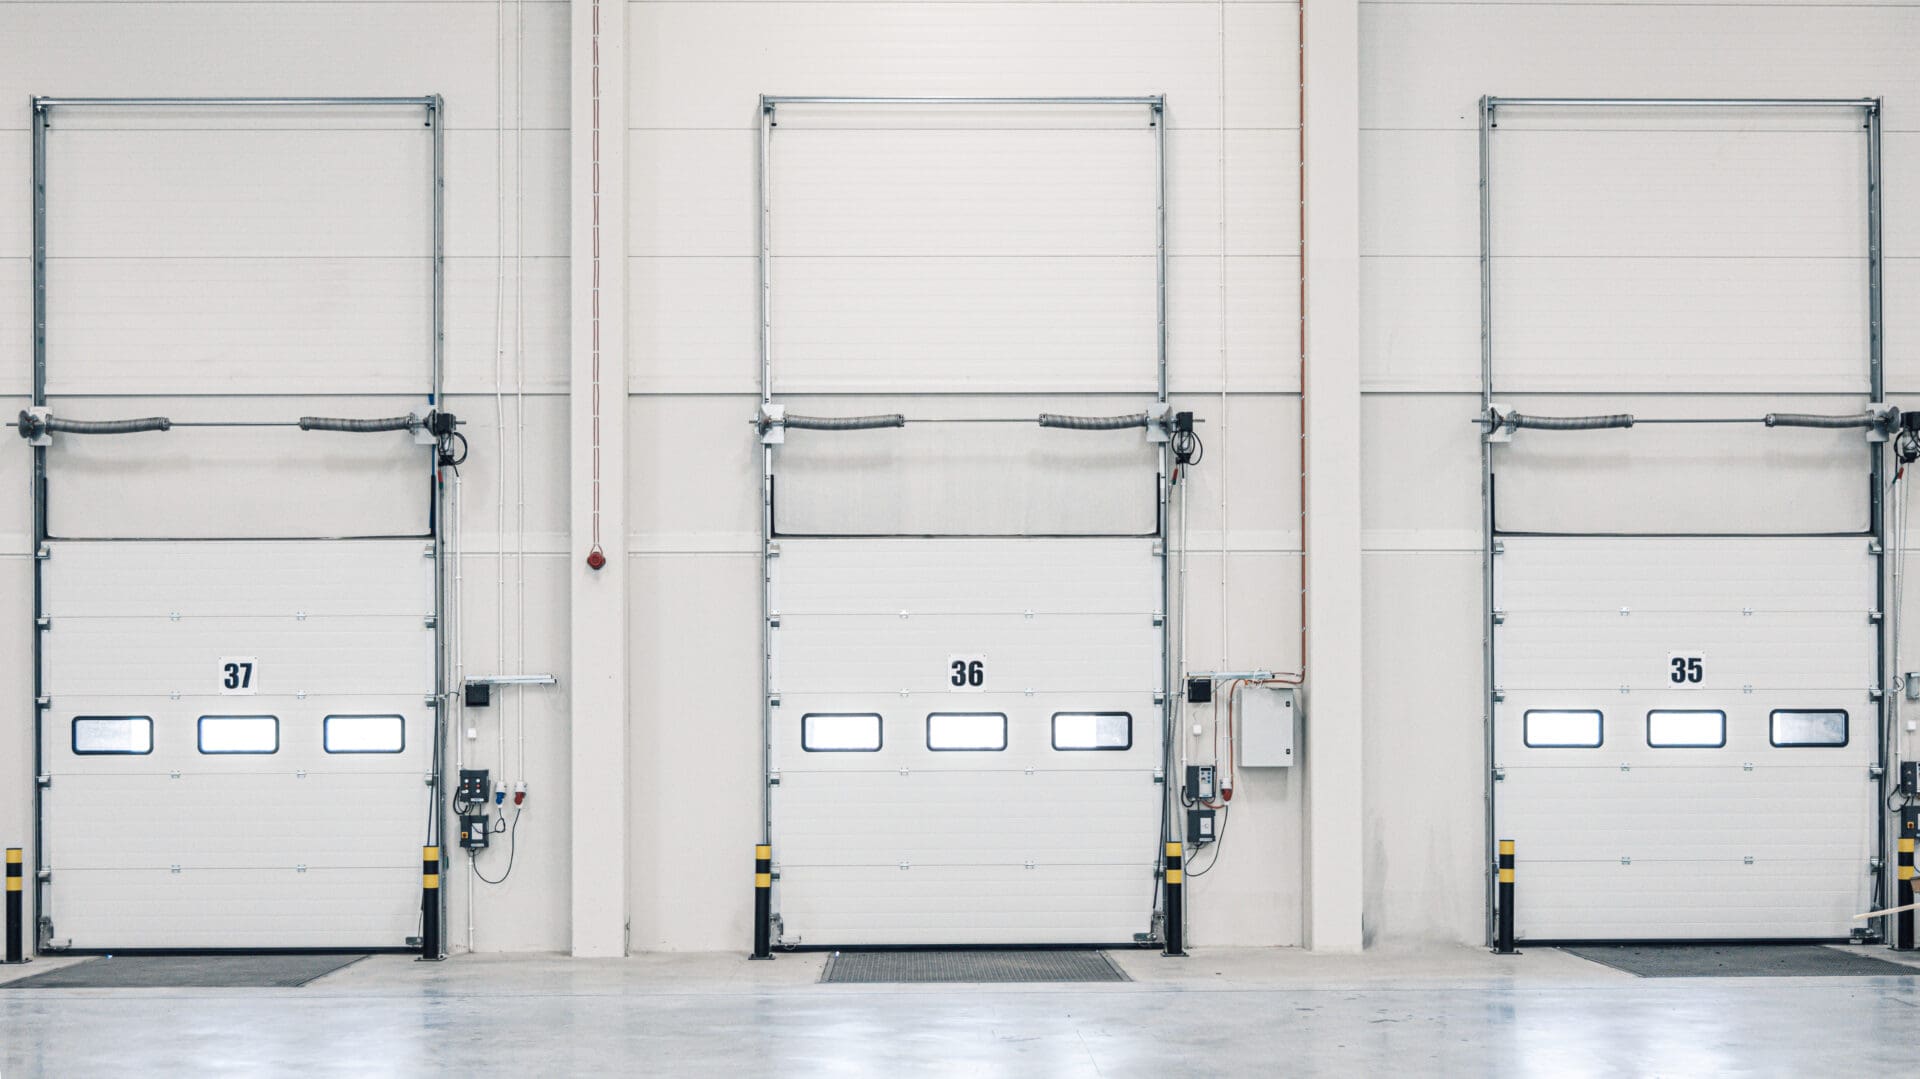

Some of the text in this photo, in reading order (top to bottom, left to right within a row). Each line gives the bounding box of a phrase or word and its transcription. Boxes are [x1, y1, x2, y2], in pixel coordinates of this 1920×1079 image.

[224, 663, 252, 689] 37
[951, 660, 984, 687] 36
[1671, 657, 1703, 684] 35
